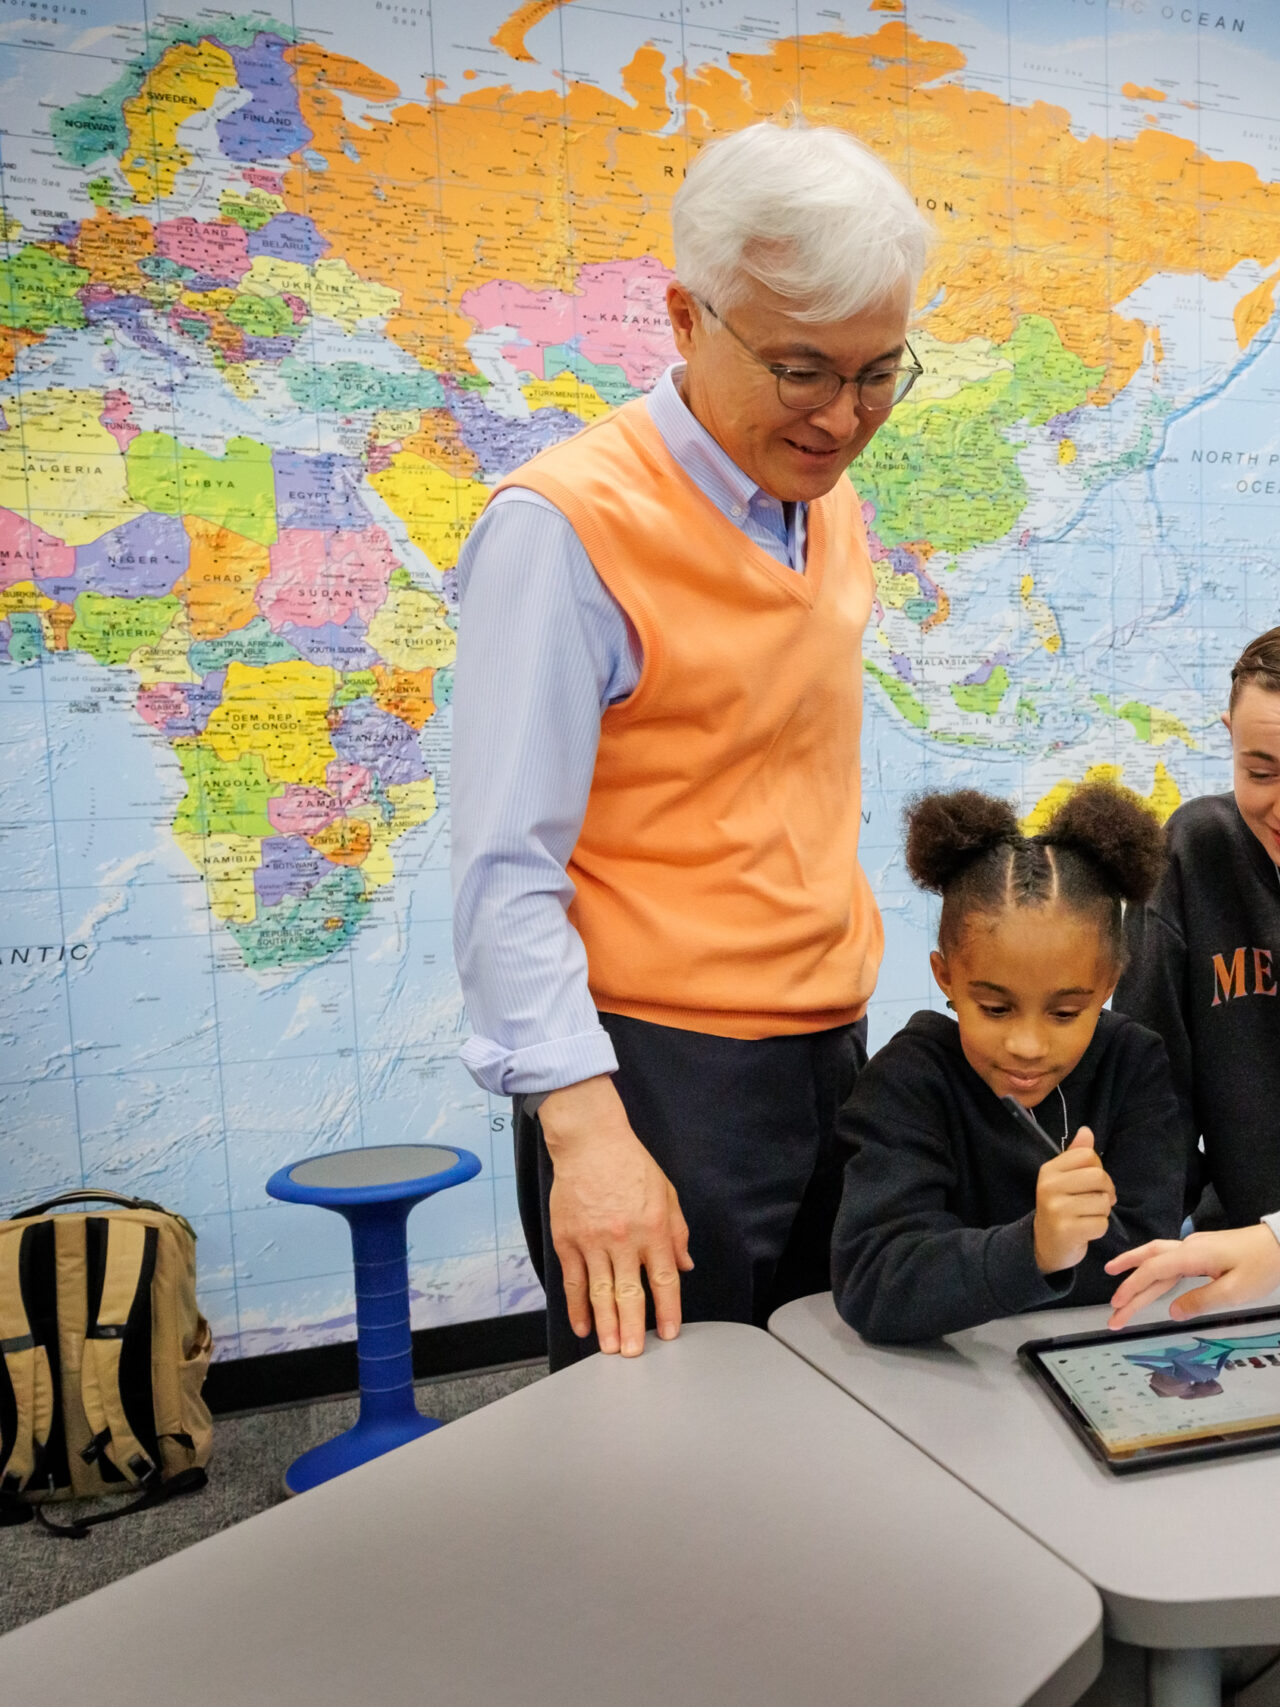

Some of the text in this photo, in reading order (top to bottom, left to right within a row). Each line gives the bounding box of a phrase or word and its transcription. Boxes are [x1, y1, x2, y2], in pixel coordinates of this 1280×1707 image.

[30, 13, 58, 25] Sea
[391, 16, 417, 27] Sea
[1161, 6, 1245, 33] OCEAN
[147, 92, 198, 105] SWEDEN
[243, 113, 292, 127] FINLAND
[64, 119, 116, 133] NORWAY
[242, 172, 277, 184] ESTONIA
[176, 225, 229, 237] POLAND
[262, 239, 311, 252] BELARUS
[282, 281, 350, 295] UKRAINE
[600, 312, 671, 327] KAZAKHS
[333, 382, 397, 394] TURKEY
[533, 389, 596, 400] TURKMENISTAN
[105, 422, 142, 432] TUNISIA
[381, 422, 414, 432] SYRIA
[422, 447, 460, 458] IRAQ
[1192, 449, 1259, 465] NORTH
[27, 463, 103, 475] ALGERIA
[184, 479, 236, 489] LIBYA
[289, 491, 329, 501] EGYPT
[0, 549, 40, 560] MALI
[108, 555, 159, 565] NIGER
[203, 573, 243, 583] CHAD
[298, 589, 353, 599] SUDAN
[102, 628, 157, 638] NIGERIA
[394, 638, 456, 647] ETHIOPIA
[338, 645, 366, 655] SUDAN
[389, 686, 421, 694] KENYA
[231, 722, 298, 731] OF CONGO
[349, 733, 413, 743] TANZANIA
[203, 778, 261, 789] ANGOLA
[296, 798, 353, 808] ZAMBIA
[203, 854, 256, 865] NAMIBIA
[0, 943, 88, 965] NTIC
